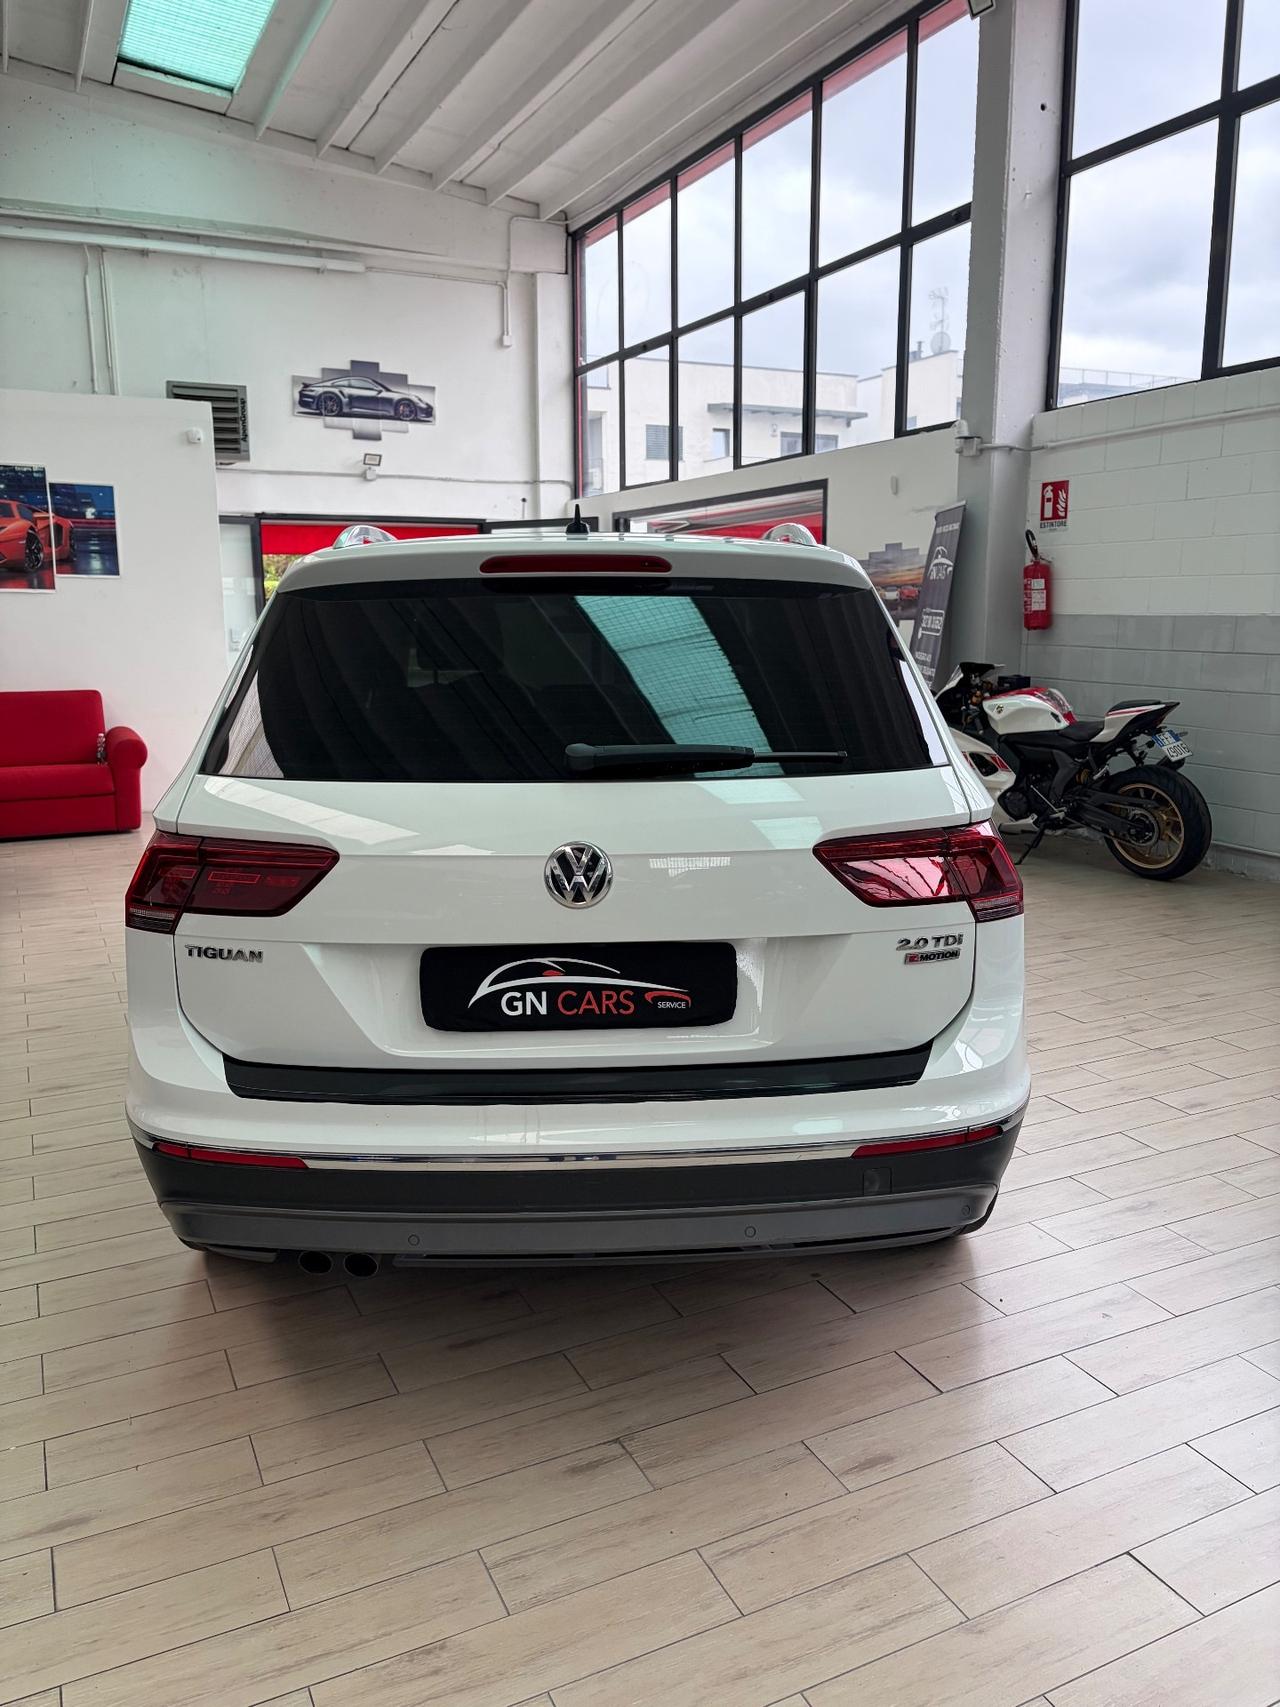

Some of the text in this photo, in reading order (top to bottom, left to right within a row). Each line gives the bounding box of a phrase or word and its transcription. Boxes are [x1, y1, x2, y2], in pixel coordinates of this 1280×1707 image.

[184, 944, 263, 963] TIGUAN
[501, 990, 635, 1015] GN CARS
[657, 1001, 686, 1009] SERVICE
